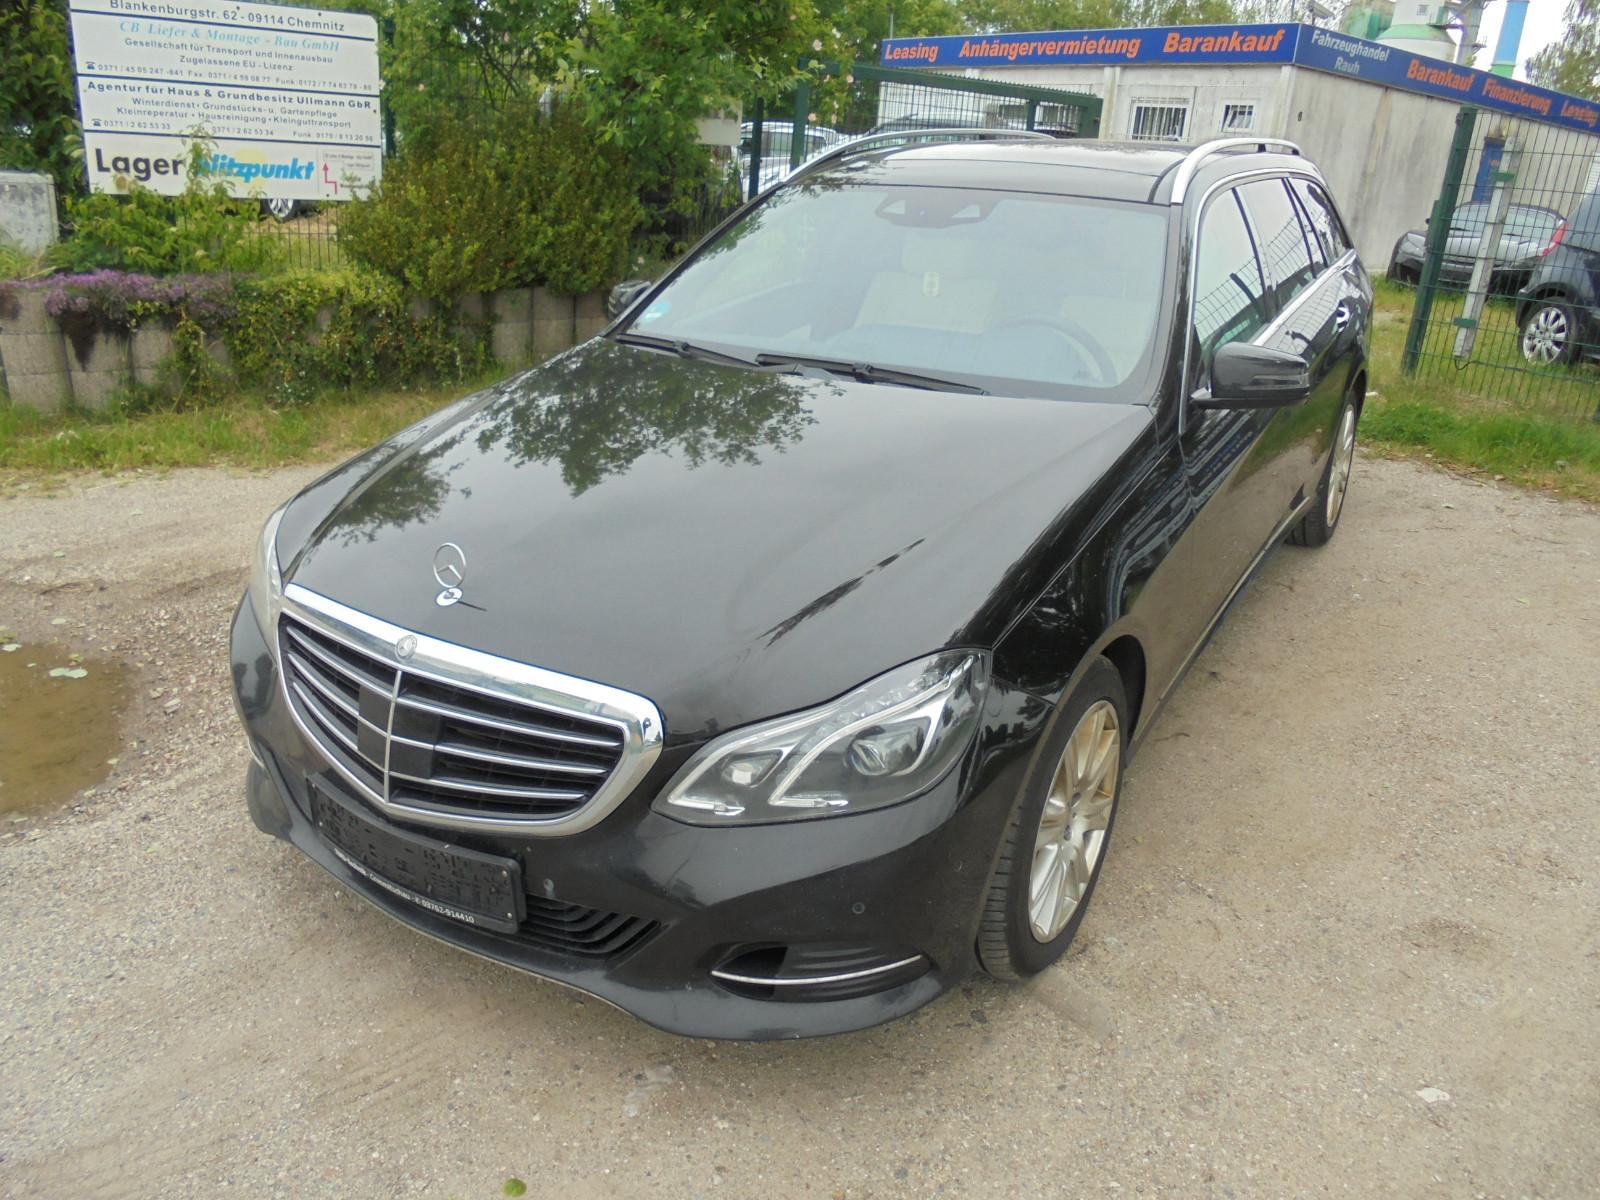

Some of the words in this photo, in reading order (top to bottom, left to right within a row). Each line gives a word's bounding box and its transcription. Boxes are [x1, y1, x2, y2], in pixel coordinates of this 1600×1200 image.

[223, 10, 237, 21] 62
[248, 12, 284, 25] 09114
[287, 16, 345, 32] Chemnitz
[119, 21, 140, 32] CB
[148, 23, 187, 39] Liefer
[191, 29, 201, 39] &
[206, 29, 261, 45] Montage
[274, 36, 299, 48] Bau
[302, 38, 340, 51] GmbH
[885, 43, 939, 62] Leasing
[959, 35, 1142, 61] Anhängervermietung
[1163, 29, 1286, 53] Barankauf
[1311, 30, 1390, 62] Fahrzeughandel
[125, 38, 188, 50] Gesellschaft
[190, 43, 204, 52] für
[206, 45, 252, 58] Transport
[255, 50, 273, 58] und
[274, 52, 333, 63] Innenausbau
[179, 55, 240, 67] Zugelassene
[242, 60, 256, 68] EU
[263, 61, 294, 71] Lizenz
[1334, 56, 1360, 75] Rauh
[87, 81, 142, 93] Agentur
[145, 85, 165, 95] für
[167, 87, 200, 97] Haus
[204, 89, 212, 98] &
[217, 91, 294, 104] Grundbesitz
[296, 96, 345, 108] Ullmann
[347, 99, 372, 109] GbR
[1407, 58, 1476, 92] Barankauf
[1481, 77, 1553, 116] Finanzierung
[116, 107, 188, 118] Kleinreperatur
[198, 113, 267, 124] Hausreinigung
[273, 116, 352, 128] Kleinguttransport
[132, 98, 195, 109] Winterdienst
[280, 107, 337, 118] Gartenpflege
[95, 147, 183, 182] Lager
